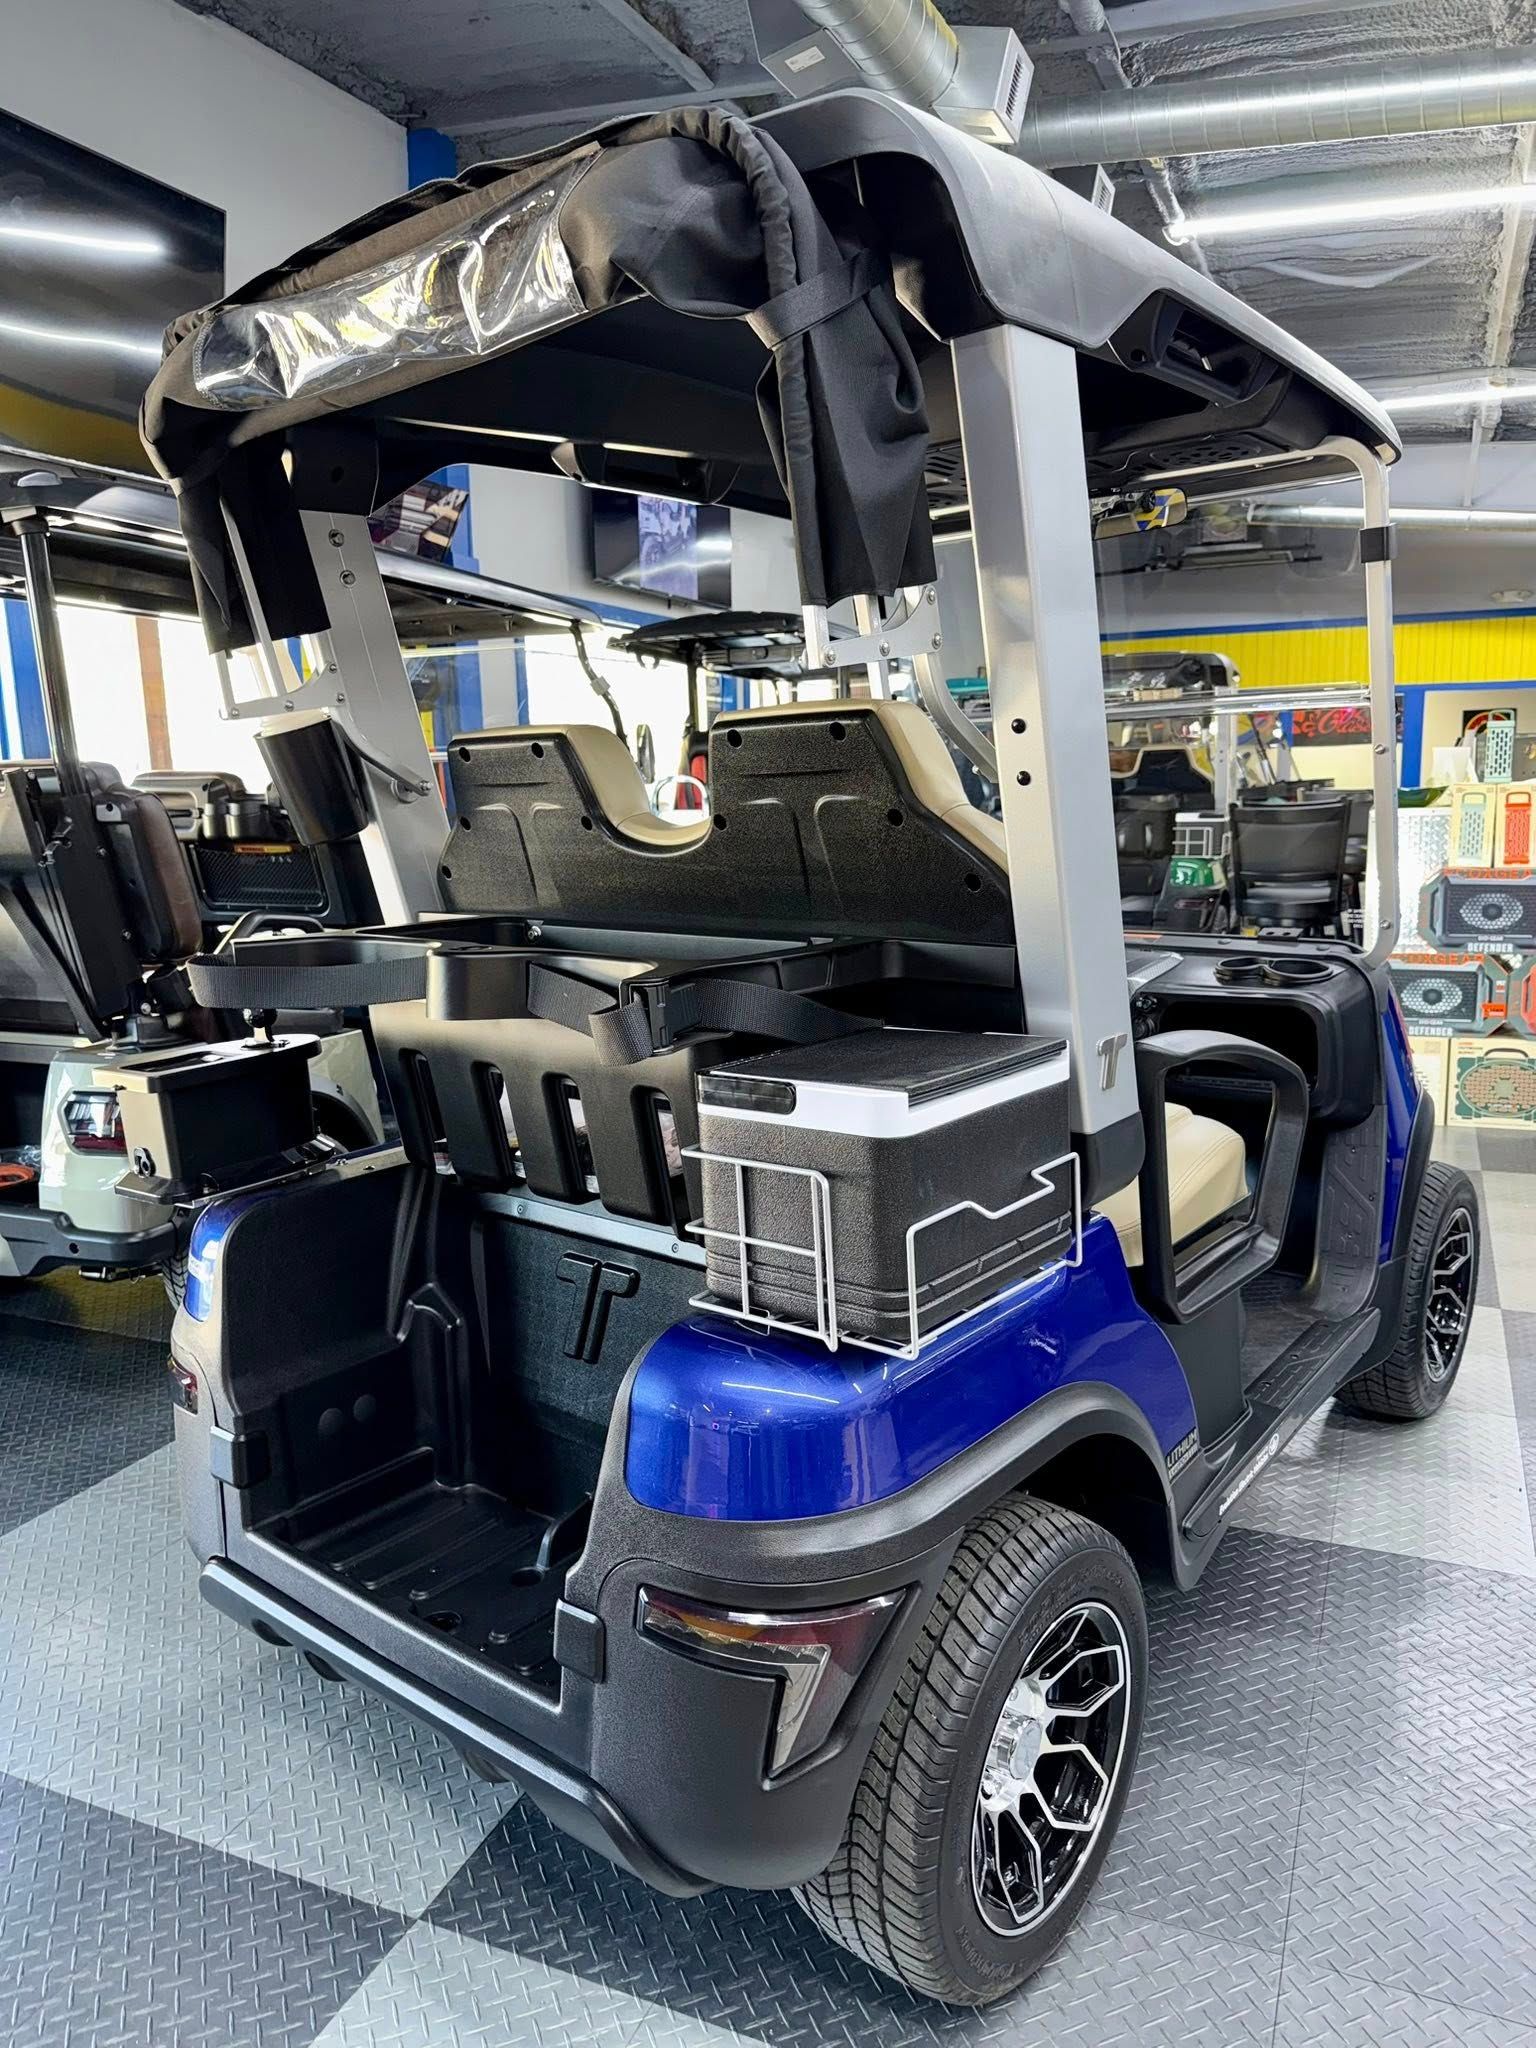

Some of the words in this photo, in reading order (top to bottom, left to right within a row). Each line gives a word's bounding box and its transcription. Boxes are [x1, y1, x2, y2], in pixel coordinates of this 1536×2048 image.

[1467, 942, 1513, 953] DEFENDER
[1409, 1026, 1453, 1036] DEFENDER
[1167, 1429, 1197, 1468] LITHIUM
